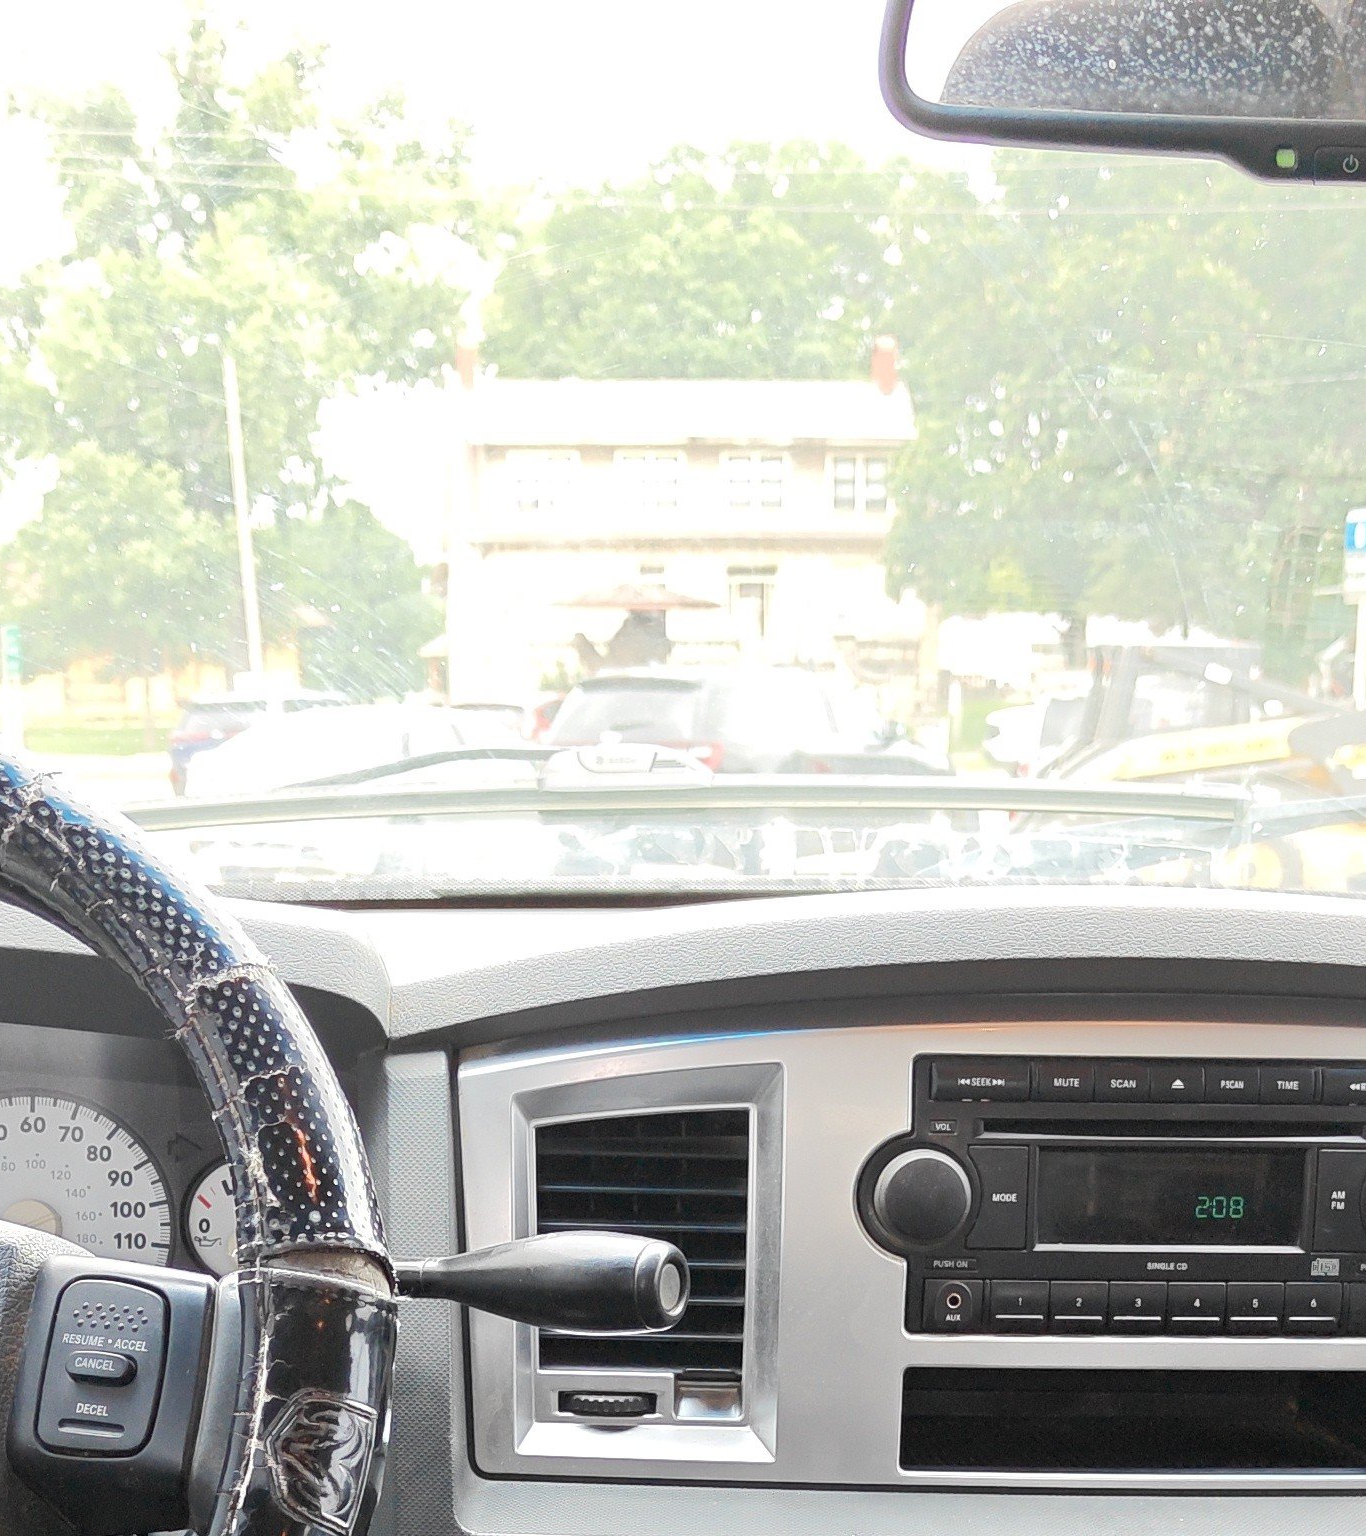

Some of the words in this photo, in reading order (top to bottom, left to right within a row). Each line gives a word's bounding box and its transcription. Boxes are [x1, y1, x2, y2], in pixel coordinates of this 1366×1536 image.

[971, 1077, 992, 1087] SEEK
[1053, 1078, 1080, 1088] MUTE
[1110, 1079, 1137, 1089] SCAN
[1276, 1081, 1299, 1090] TIME
[20, 1116, 46, 1134] 60
[935, 1123, 952, 1131] VOL
[58, 1126, 84, 1143] 70
[86, 1145, 112, 1162] 80
[1, 1161, 16, 1172] 80
[25, 1159, 46, 1170] 100
[51, 1170, 71, 1180] 120
[107, 1170, 133, 1187] 90
[65, 1188, 87, 1198] 140
[992, 1193, 1017, 1203] MODE
[1331, 1190, 1346, 1200] AM
[109, 1201, 146, 1219] 100
[1331, 1201, 1345, 1210] FM
[76, 1211, 96, 1221] 160
[77, 1234, 97, 1244] 180
[113, 1232, 147, 1250] 110
[933, 1260, 954, 1268] PUSH
[956, 1260, 968, 1269] ON
[1146, 1262, 1175, 1271] SINGLE
[1176, 1262, 1188, 1271] CD
[1018, 1297, 1023, 1306] 1
[1075, 1298, 1083, 1307] 2
[1135, 1298, 1142, 1308] 3
[1193, 1298, 1201, 1308] 4
[1252, 1298, 1259, 1308] 5
[1310, 1298, 1317, 1308] 6
[945, 1313, 961, 1321] AUX
[62, 1333, 105, 1347] RESUME
[113, 1338, 149, 1352] ACCEL
[75, 1356, 115, 1371] CANCEL
[76, 1402, 109, 1417] DECEL
